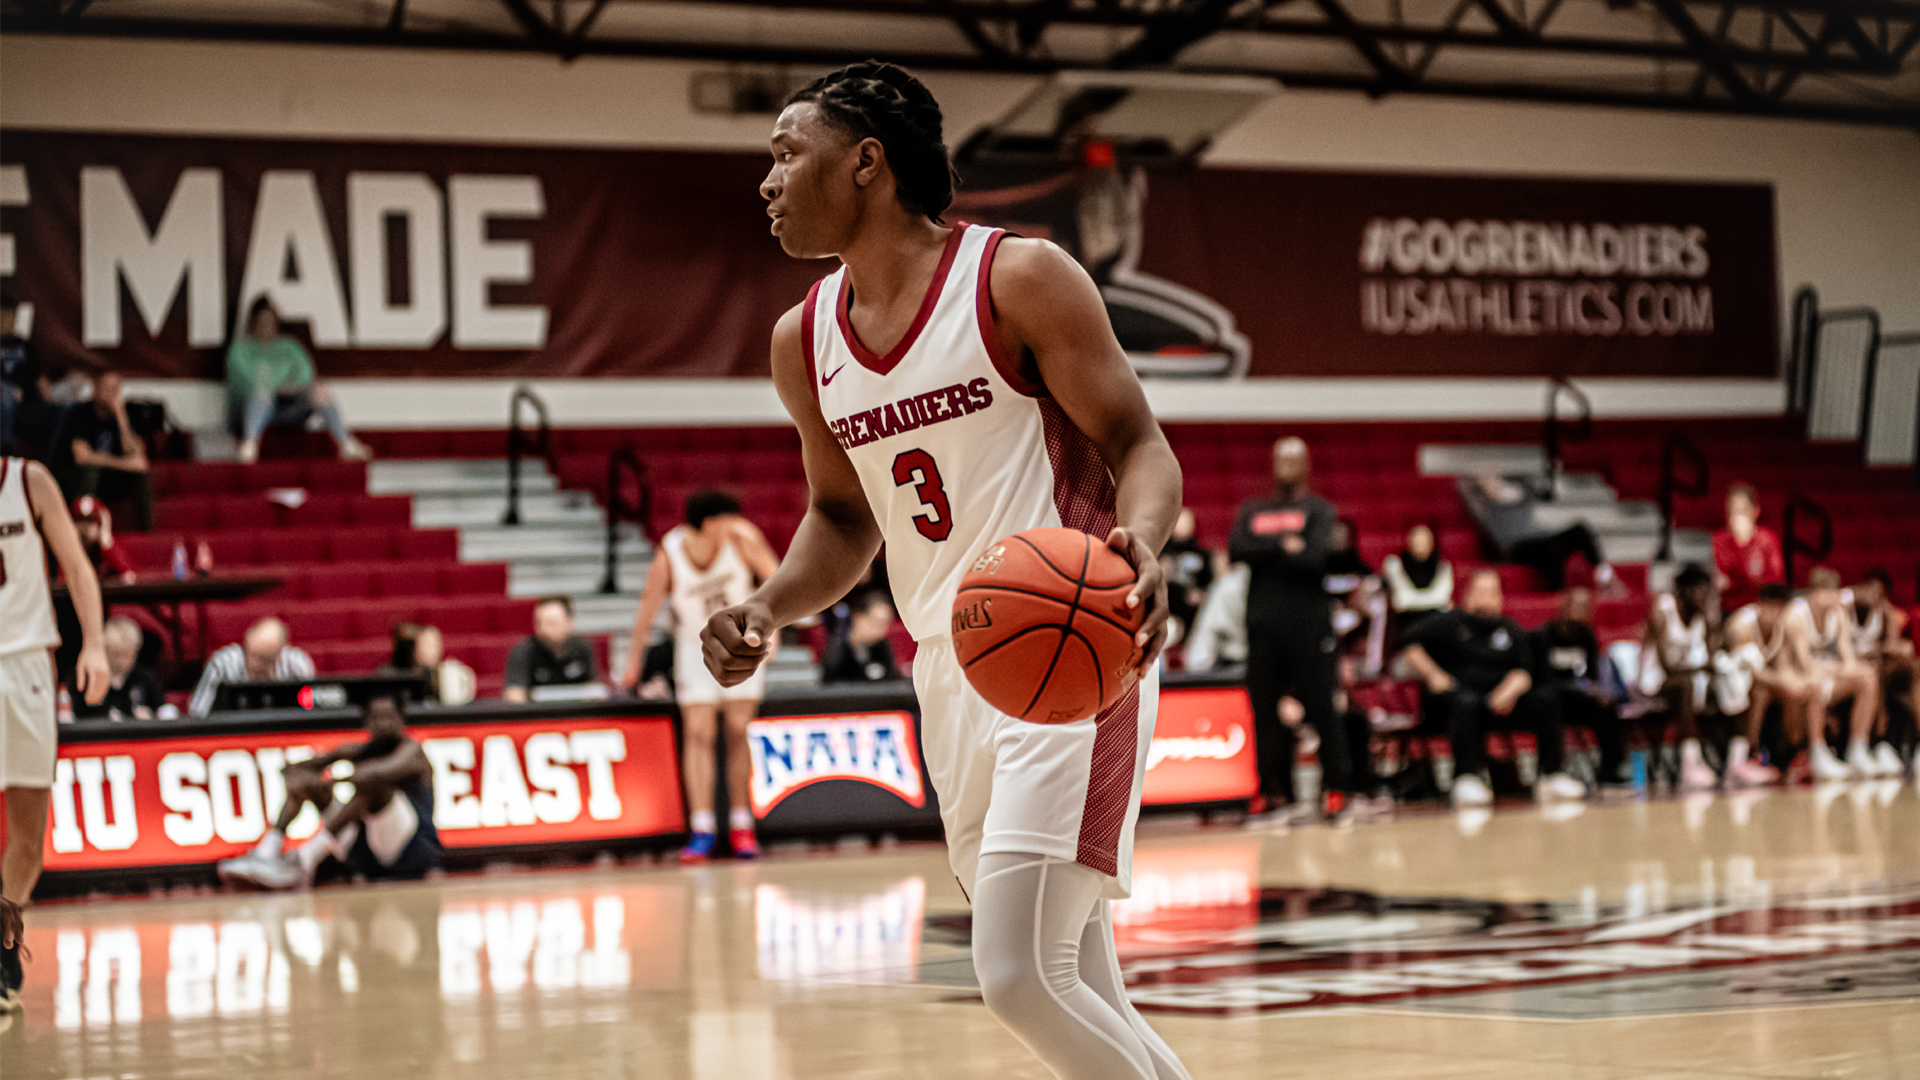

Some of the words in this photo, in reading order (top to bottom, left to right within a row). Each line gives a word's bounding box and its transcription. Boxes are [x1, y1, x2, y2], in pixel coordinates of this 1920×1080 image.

[80, 165, 550, 350] MADE
[1361, 218, 1709, 277] #GOGRENADIERS
[1362, 278, 1714, 336] IUSATHLETICS.COM
[891, 447, 953, 543] 3
[752, 728, 906, 789] NAIA
[52, 755, 139, 853] IU
